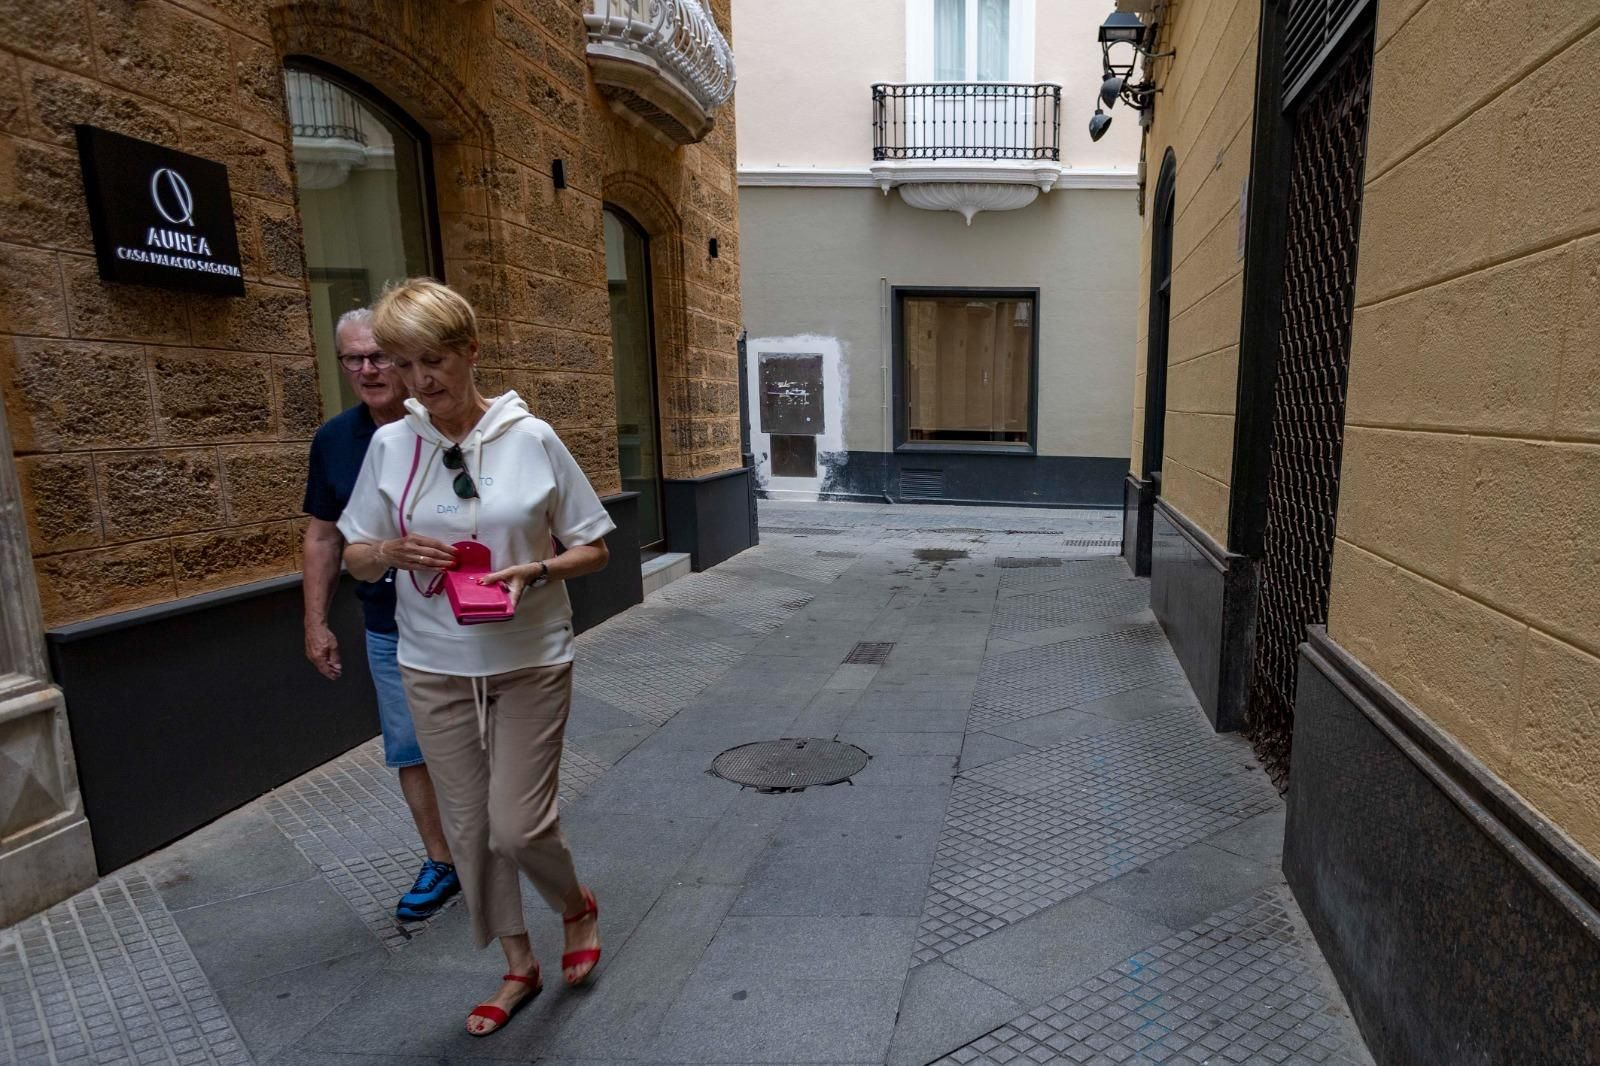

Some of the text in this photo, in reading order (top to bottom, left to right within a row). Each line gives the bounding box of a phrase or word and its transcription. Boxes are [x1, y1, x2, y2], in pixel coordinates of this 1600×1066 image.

[147, 227, 212, 256] AUREA
[117, 247, 150, 263] CASA
[150, 252, 197, 270] PALACIO
[436, 504, 459, 514] DAY
